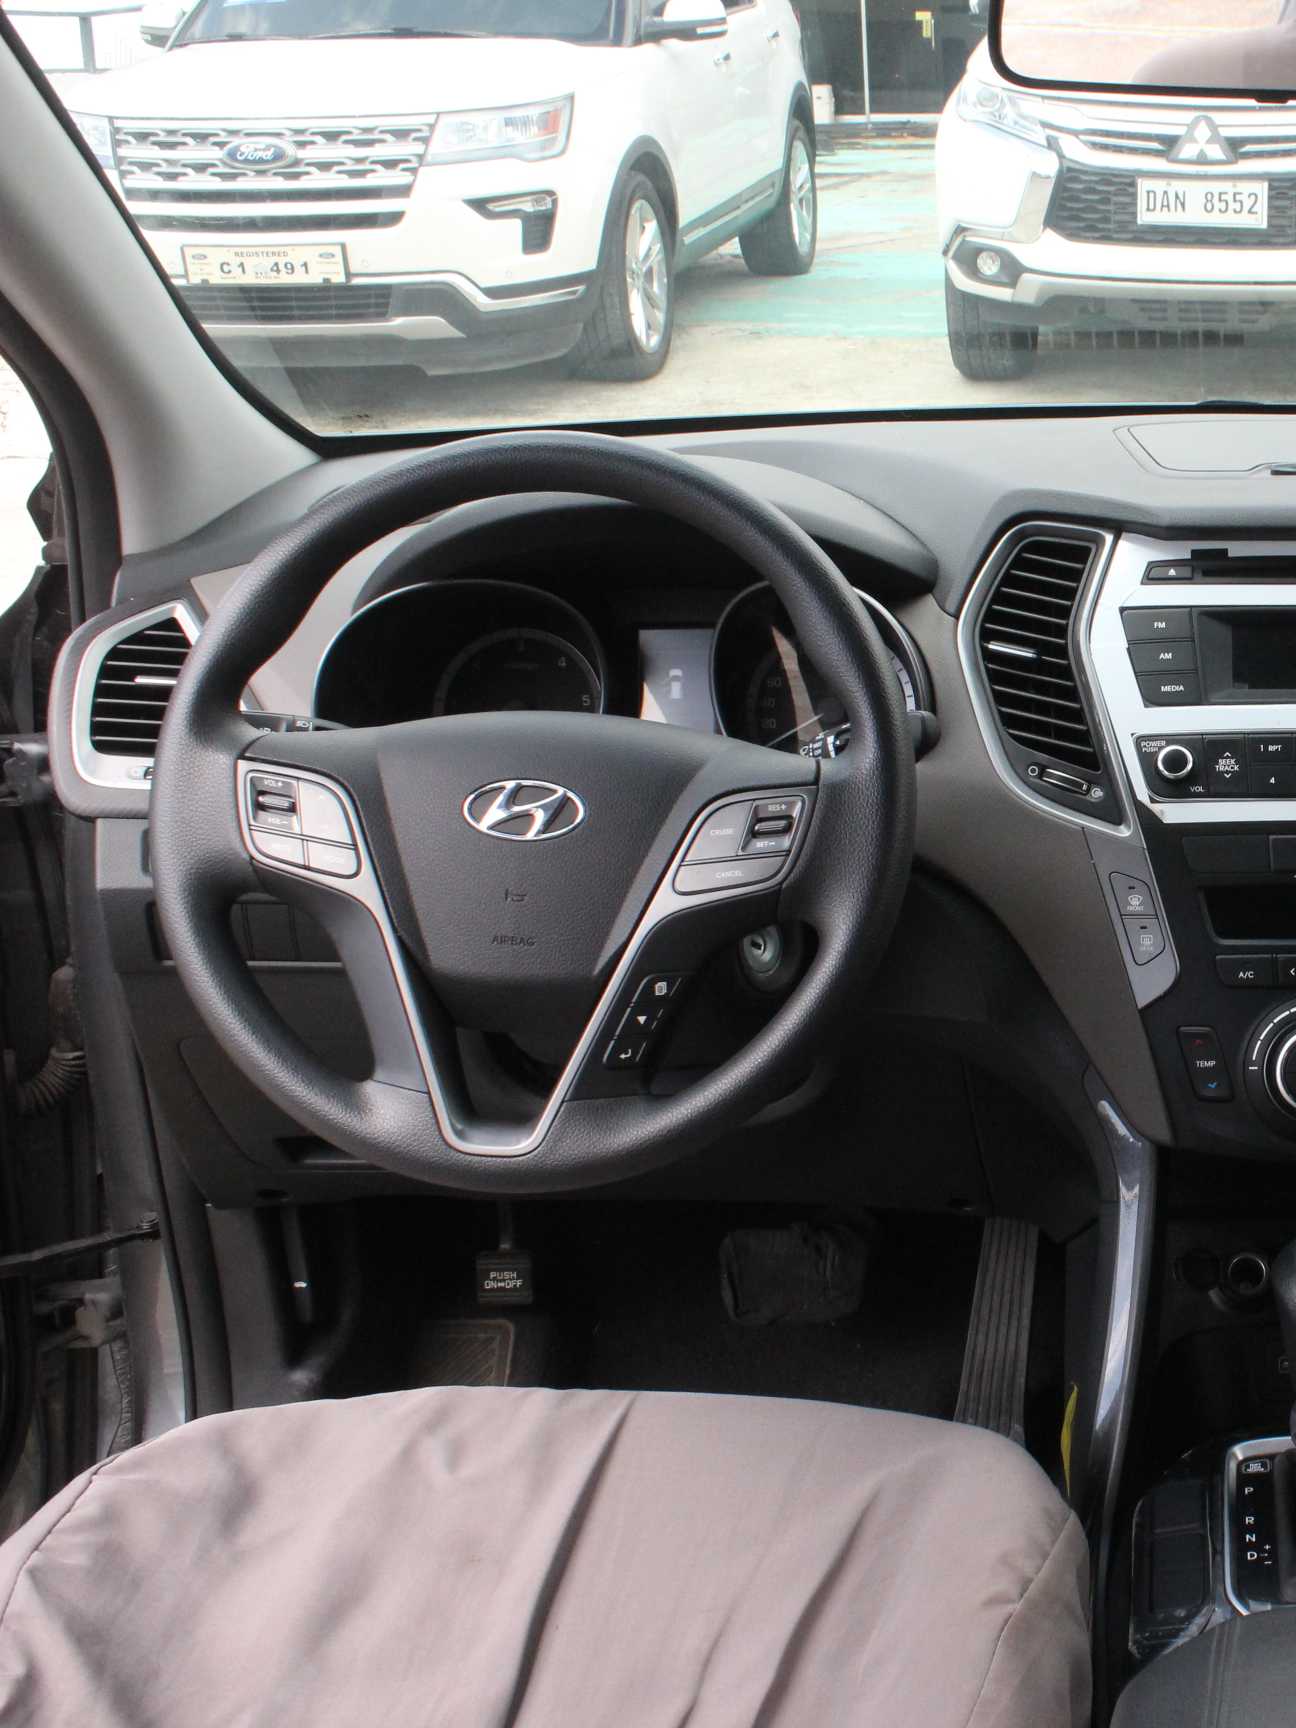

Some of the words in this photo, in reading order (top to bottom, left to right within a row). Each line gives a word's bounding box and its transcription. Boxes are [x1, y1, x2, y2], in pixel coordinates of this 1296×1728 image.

[236, 143, 275, 161] Ford
[1145, 190, 1186, 213] DAN
[1203, 191, 1259, 215] 8552
[233, 250, 289, 258] REGISTERED
[219, 261, 246, 275] C1
[269, 261, 311, 275] 491
[1153, 621, 1167, 629] FM
[1158, 651, 1173, 660] AM
[558, 656, 568, 668] 4
[1160, 684, 1185, 693] MEDIA
[582, 694, 591, 706] 5
[1267, 744, 1283, 752] RPT
[1214, 764, 1240, 772] TRACK
[1269, 776, 1276, 785] 4
[1189, 785, 1205, 793] VOL
[490, 934, 537, 947] AIRBAG
[1237, 970, 1254, 979] A/C
[1195, 1060, 1217, 1069] TEMP
[489, 1271, 517, 1280] PUSH
[1245, 1487, 1254, 1495] P
[1245, 1516, 1255, 1525] R
[1246, 1534, 1256, 1543] N
[1247, 1551, 1258, 1560] D
